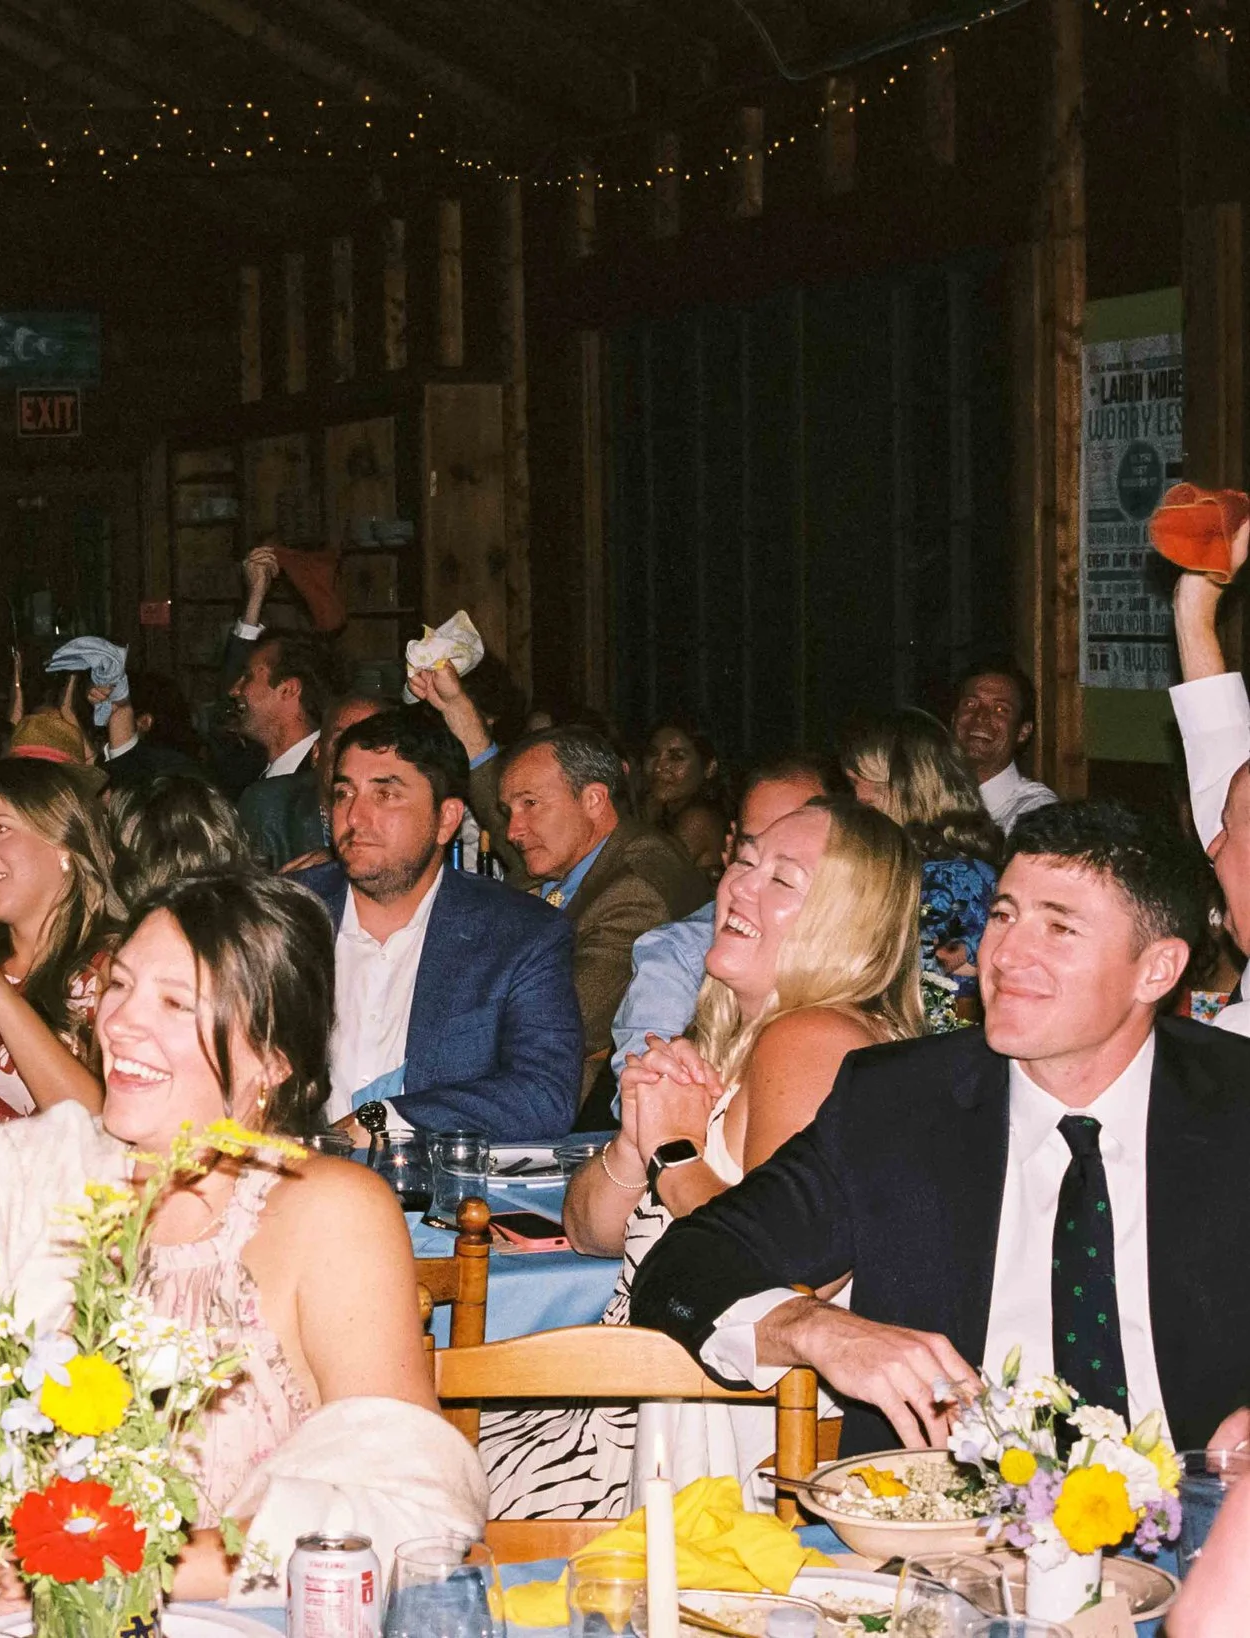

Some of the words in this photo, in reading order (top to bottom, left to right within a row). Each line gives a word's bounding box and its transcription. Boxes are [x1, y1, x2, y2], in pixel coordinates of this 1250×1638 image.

[1101, 373, 1143, 405] LAUGH
[1149, 368, 1183, 402] MORE
[21, 396, 75, 430] EXIT
[1088, 405, 1152, 441] WORRY
[1157, 402, 1183, 437] LES
[1087, 553, 1109, 568] EVERY
[1123, 646, 1168, 672] AWESO
